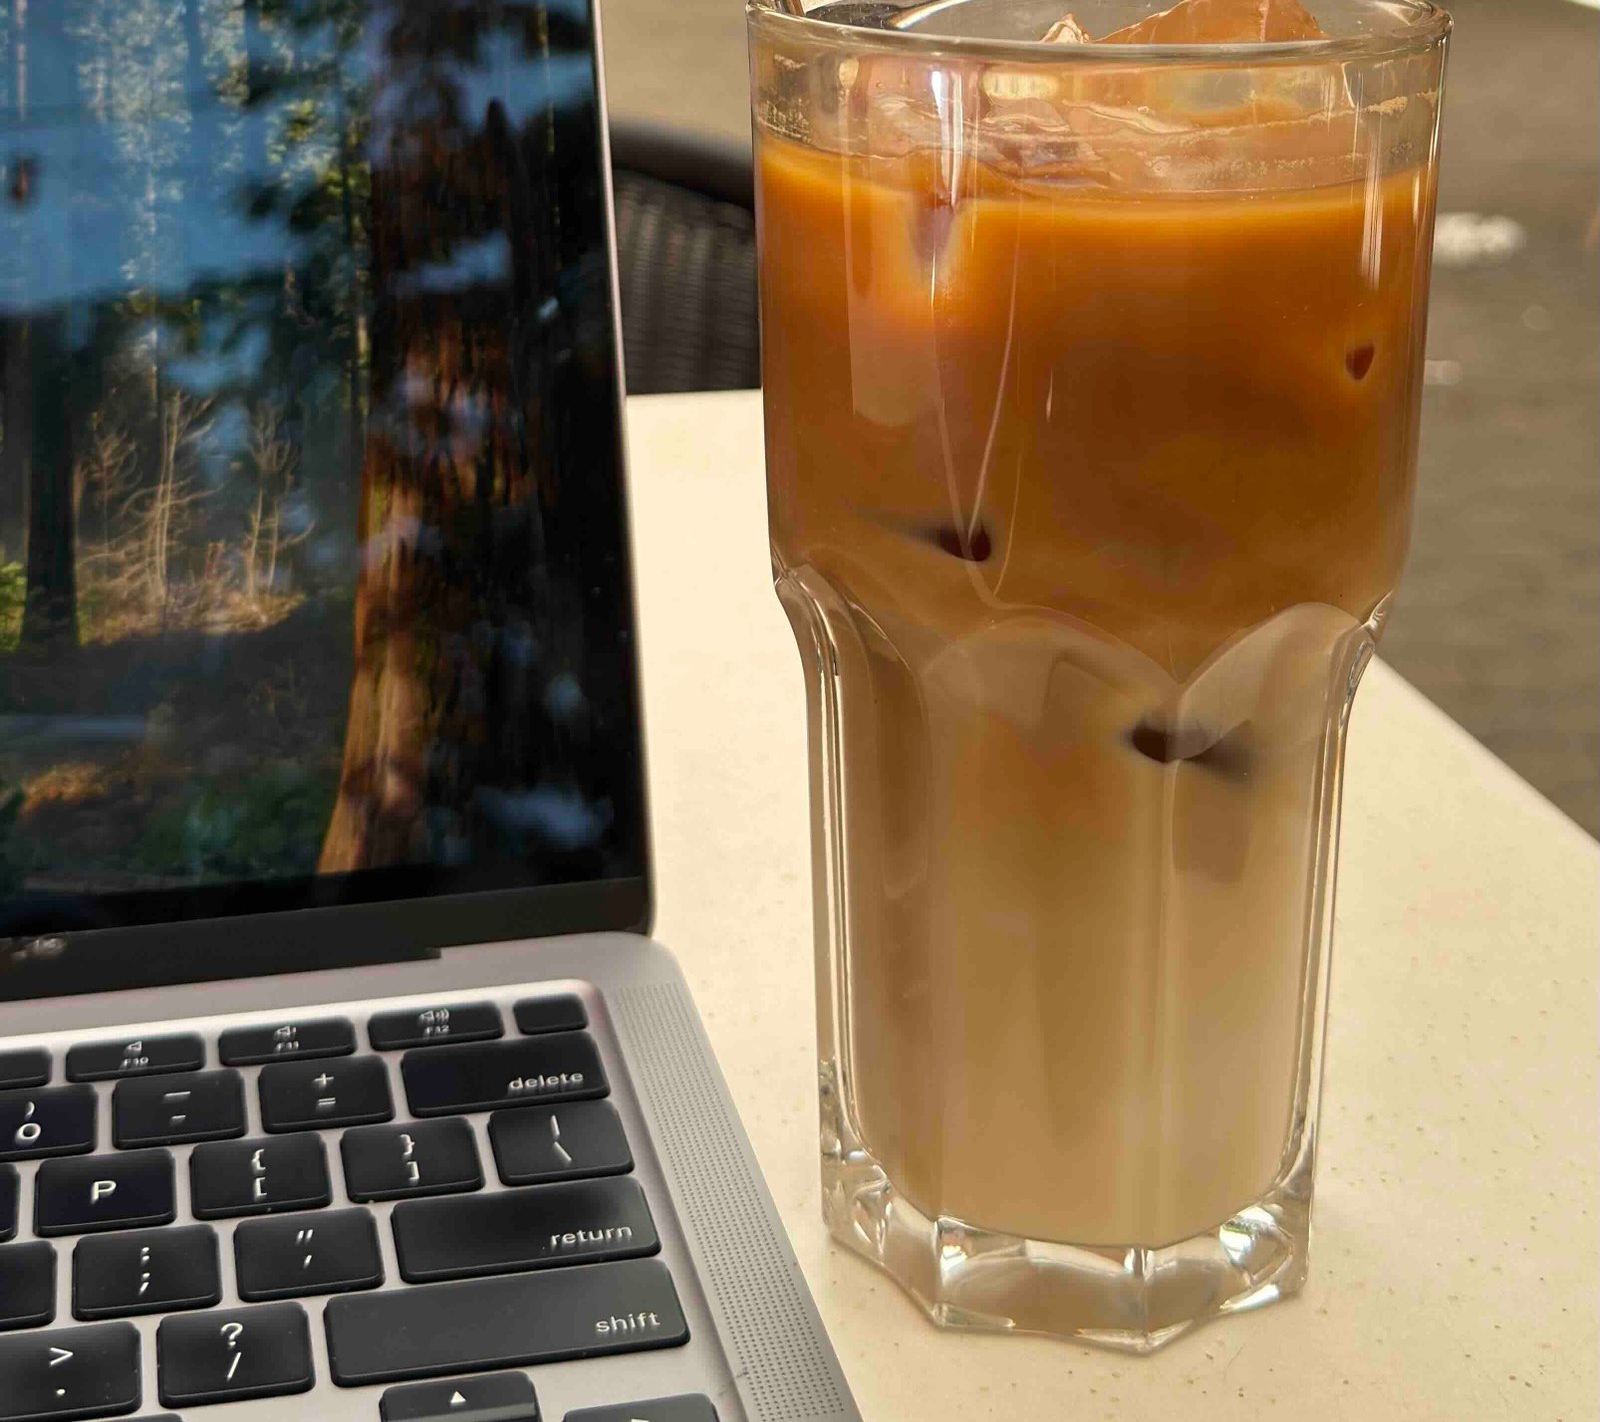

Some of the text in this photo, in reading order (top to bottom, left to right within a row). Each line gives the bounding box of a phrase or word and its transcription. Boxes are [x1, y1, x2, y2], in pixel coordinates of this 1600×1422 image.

[314, 1073, 334, 1086] +
[508, 1070, 583, 1091] delete
[318, 1097, 336, 1106] =
[399, 1135, 415, 1154] }
[251, 1149, 266, 1170] {
[407, 1161, 419, 1181] ]
[92, 1180, 116, 1203] P
[254, 1178, 267, 1198] [
[550, 1224, 632, 1247] return
[141, 1247, 150, 1263] :
[139, 1272, 151, 1295] ;
[596, 1311, 660, 1333] shift
[220, 1322, 243, 1346] ?
[49, 1347, 73, 1366] >
[226, 1352, 242, 1381] /
